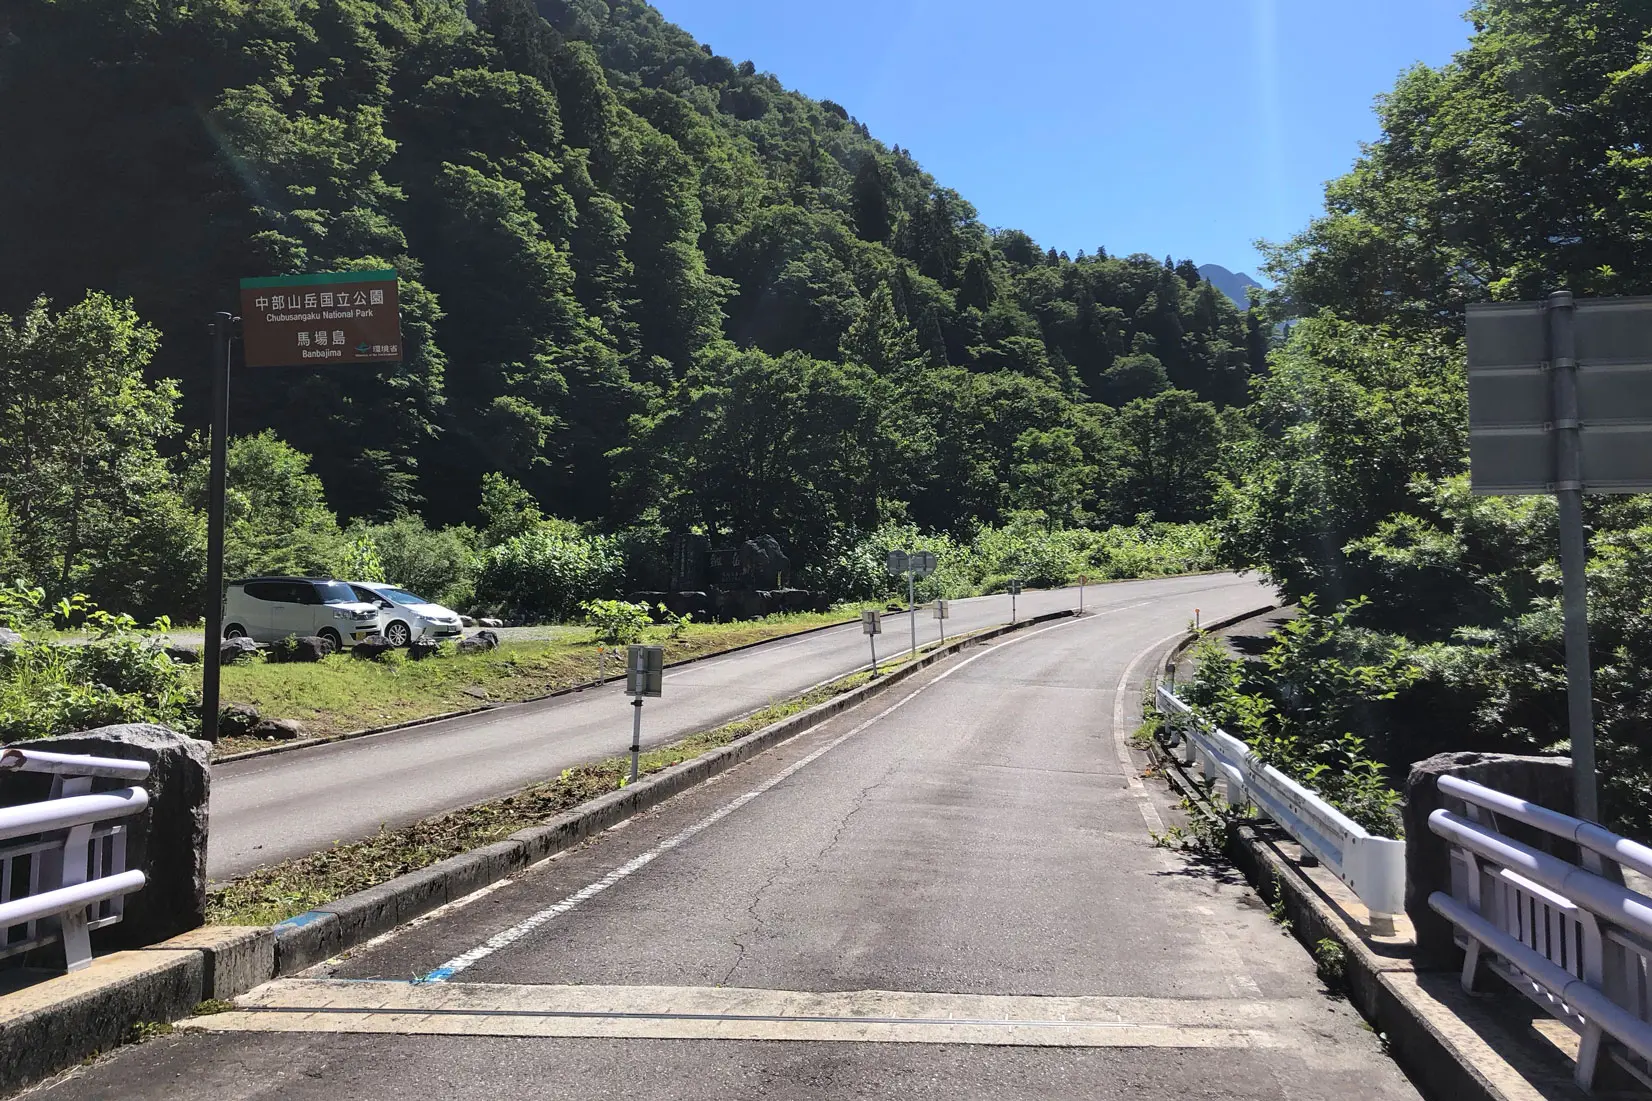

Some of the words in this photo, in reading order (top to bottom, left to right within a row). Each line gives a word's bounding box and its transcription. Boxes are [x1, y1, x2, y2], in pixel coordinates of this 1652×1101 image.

[255, 289, 384, 311] 中部山岳国立公園
[266, 313, 321, 323] Chubusangaku
[322, 310, 353, 319] National
[355, 309, 373, 317] Park
[297, 330, 346, 346] 馬場島
[302, 349, 342, 359] Banbajima
